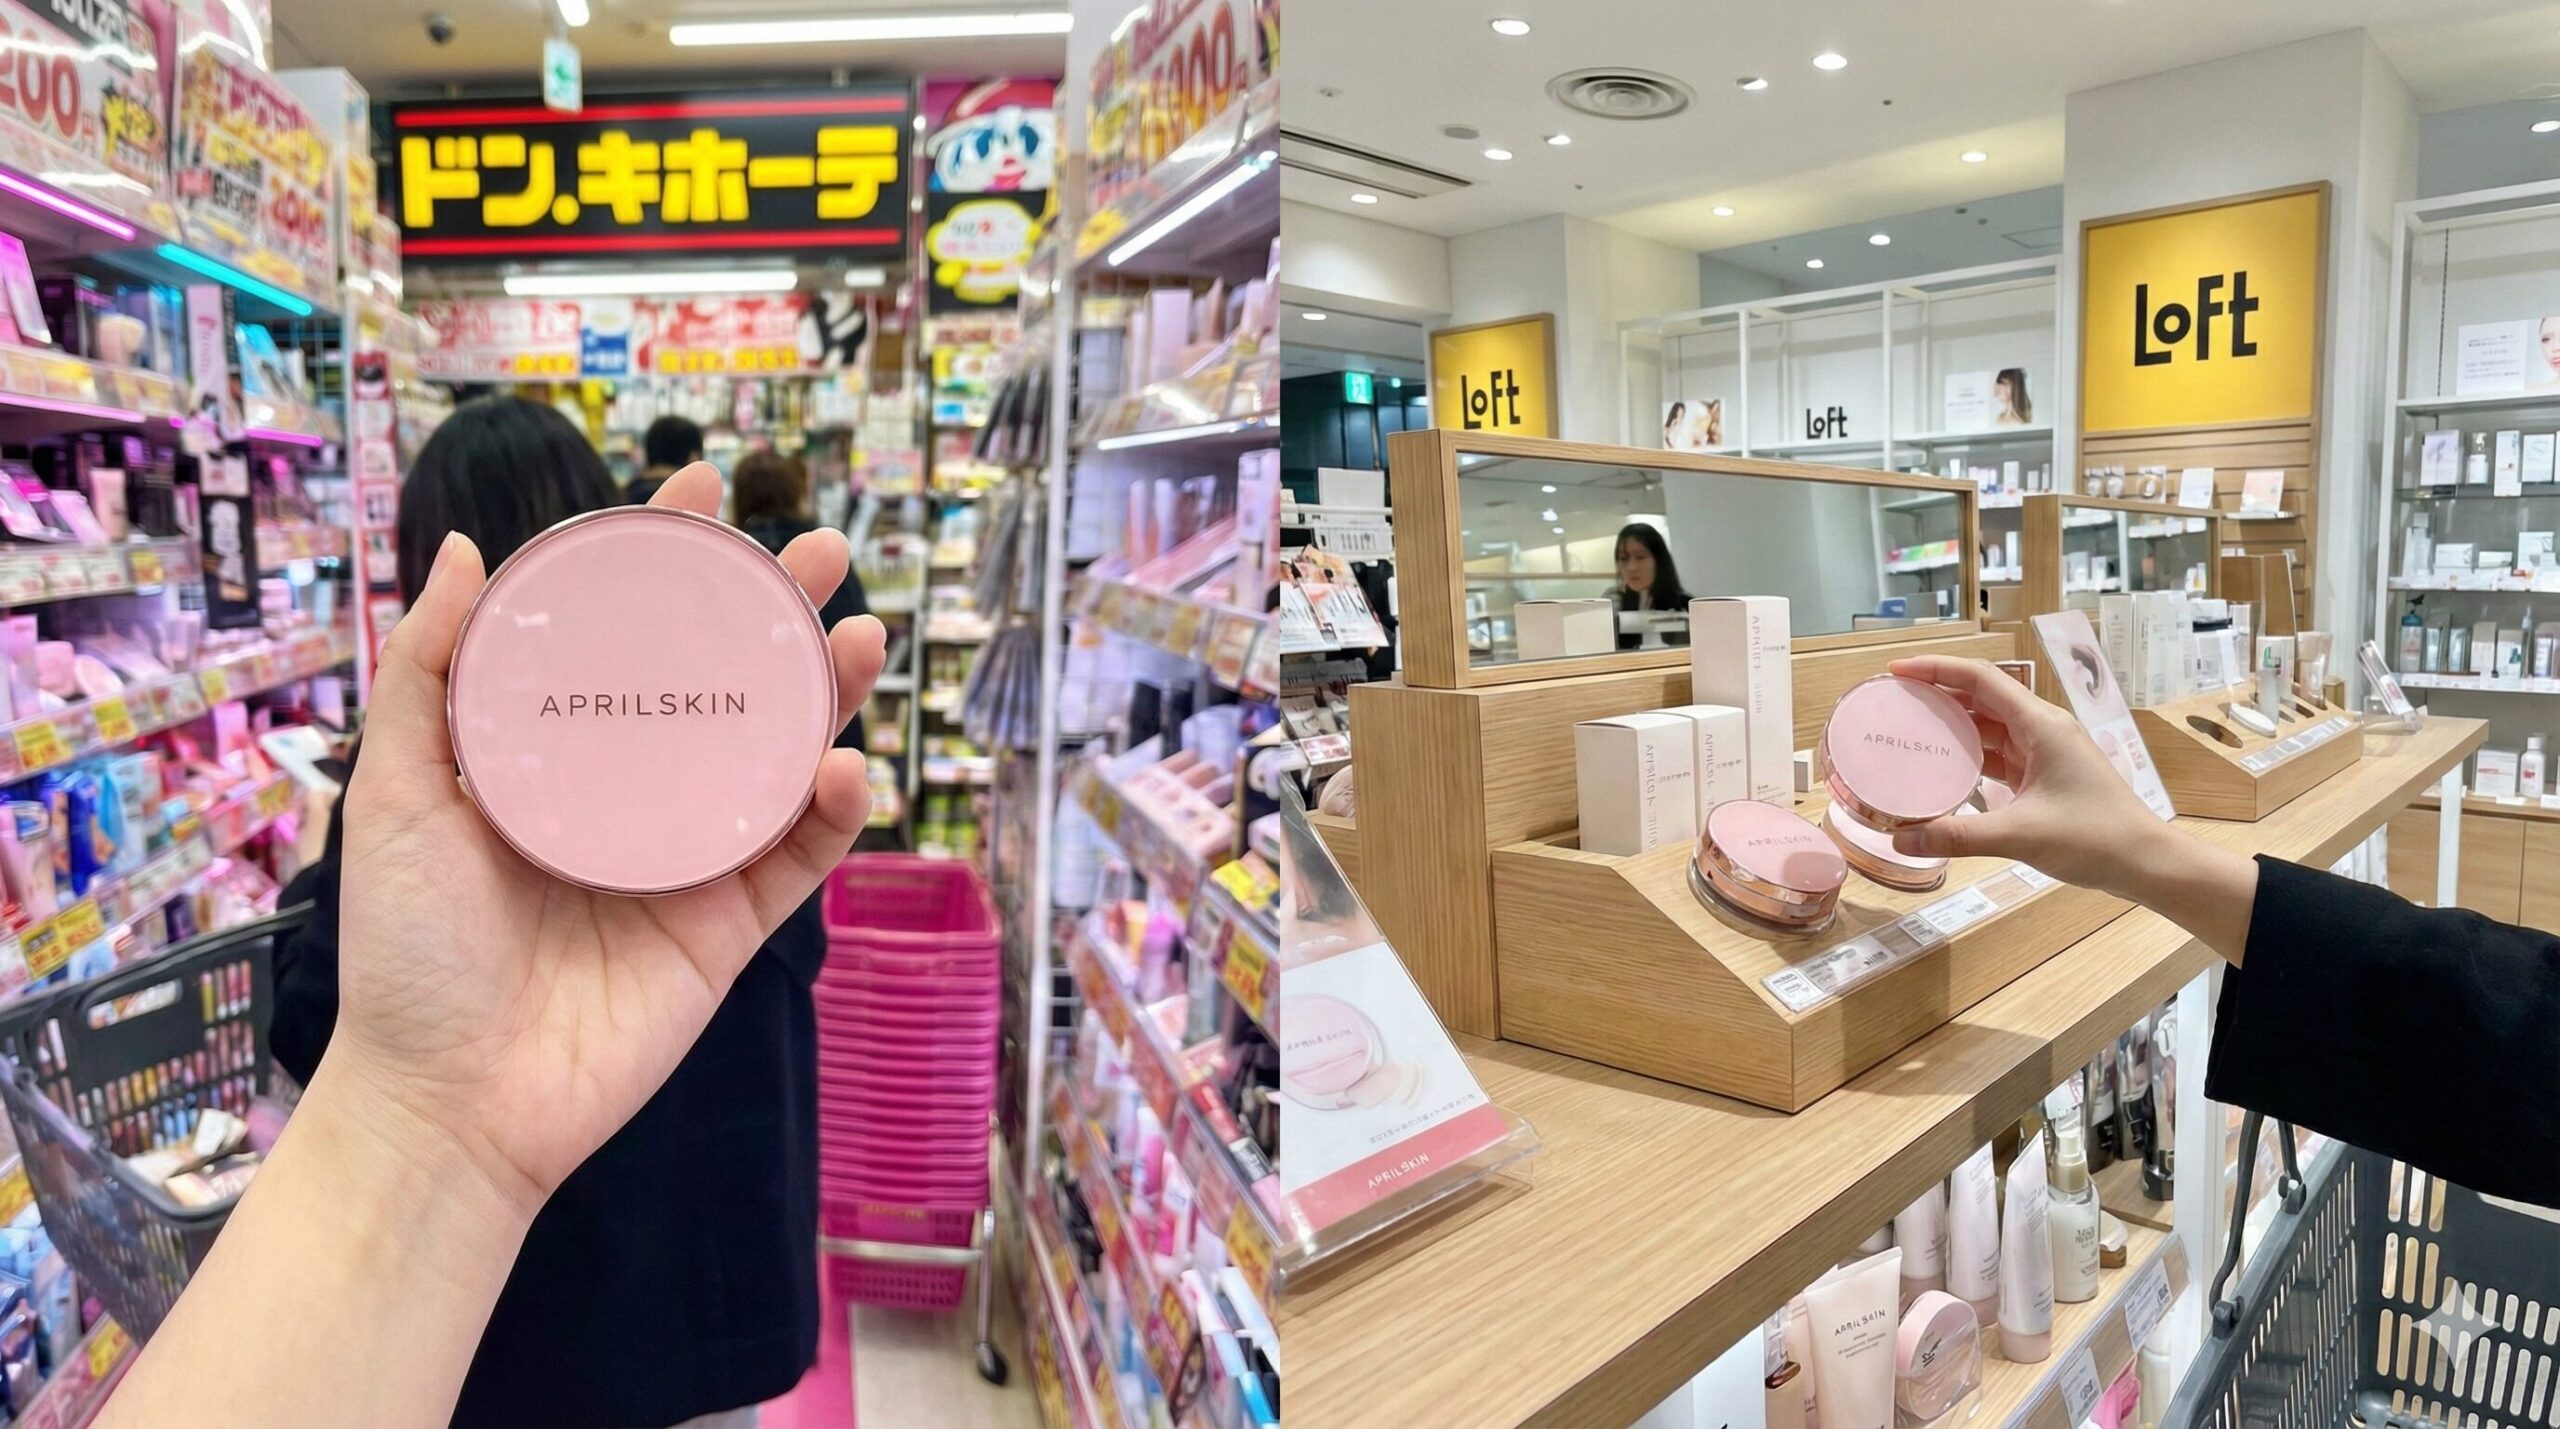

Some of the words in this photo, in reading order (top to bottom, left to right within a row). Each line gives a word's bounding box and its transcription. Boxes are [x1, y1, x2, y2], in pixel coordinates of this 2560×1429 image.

[540, 692, 746, 718] APRILSKIN
[1864, 732, 1951, 758] APRILSKIN
[1367, 1152, 1430, 1189] APRILSKIN
